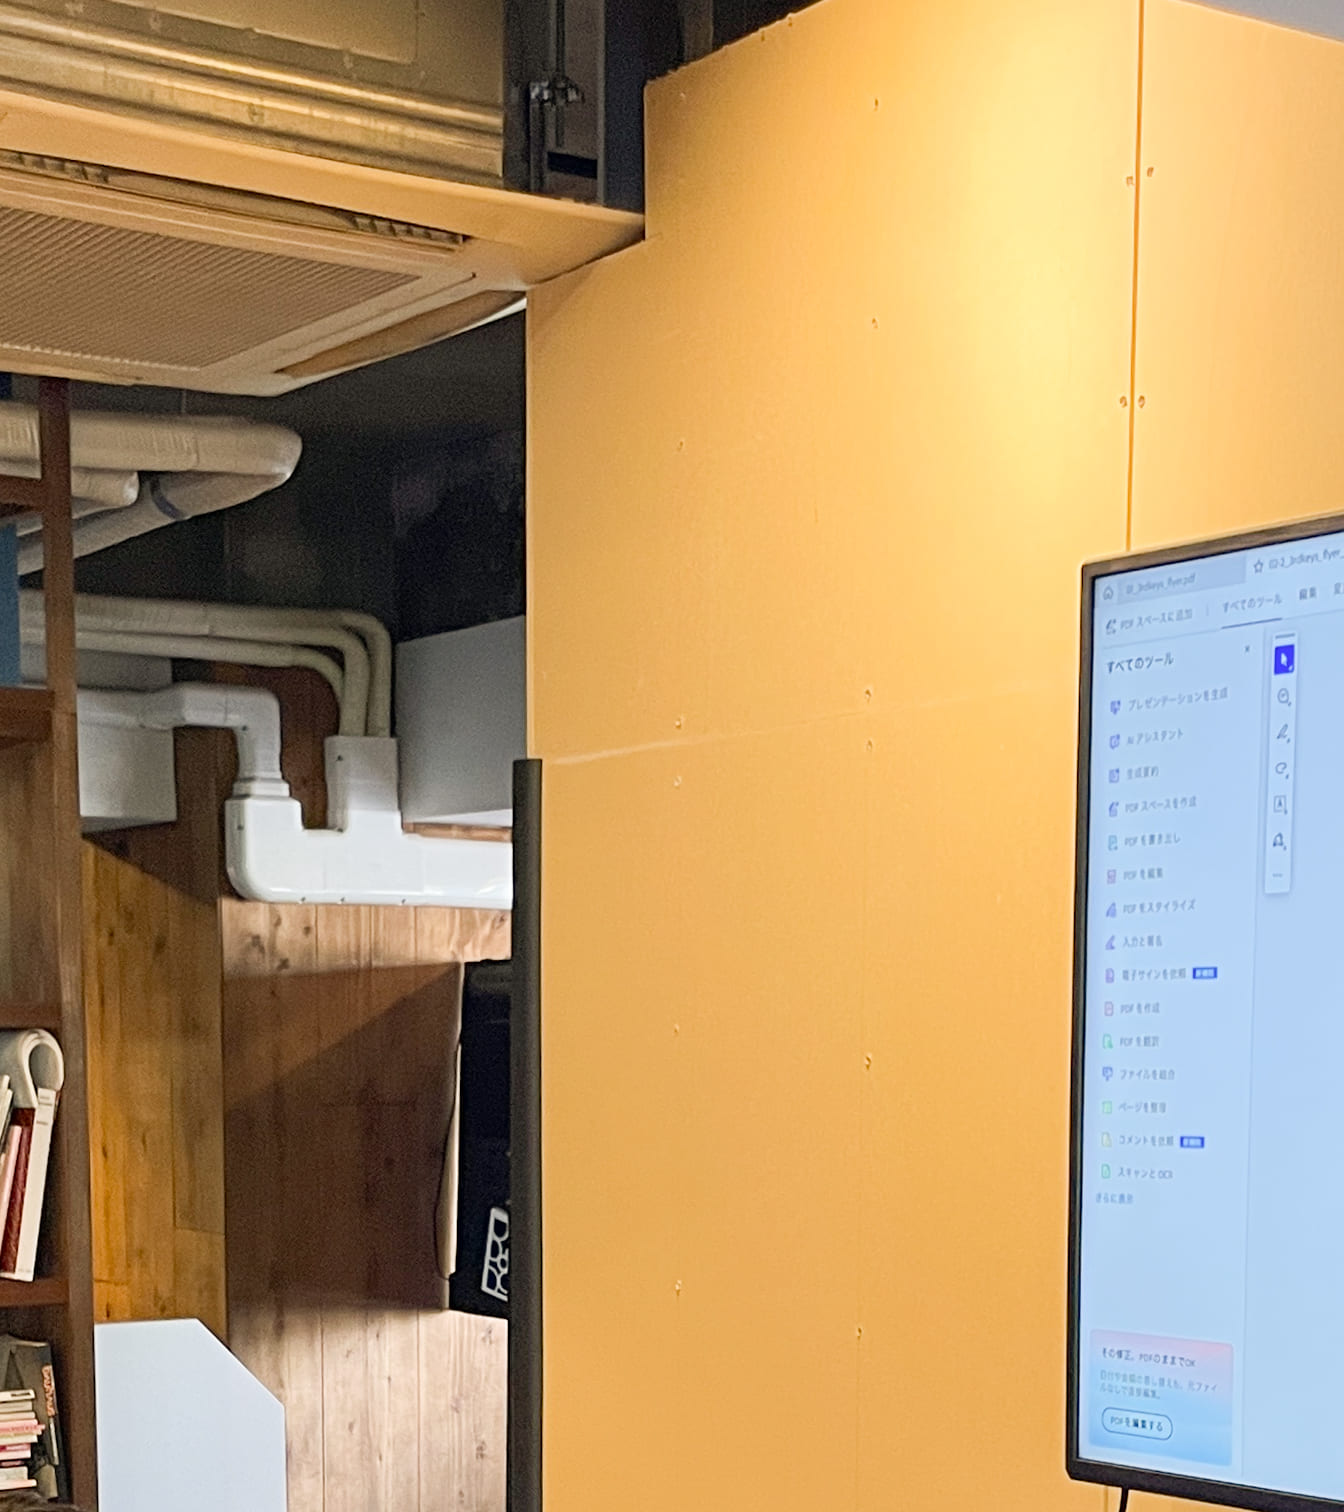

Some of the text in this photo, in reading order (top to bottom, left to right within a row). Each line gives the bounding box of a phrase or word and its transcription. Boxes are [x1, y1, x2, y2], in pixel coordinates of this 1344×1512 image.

[1107, 651, 1174, 674] すべてのツール
